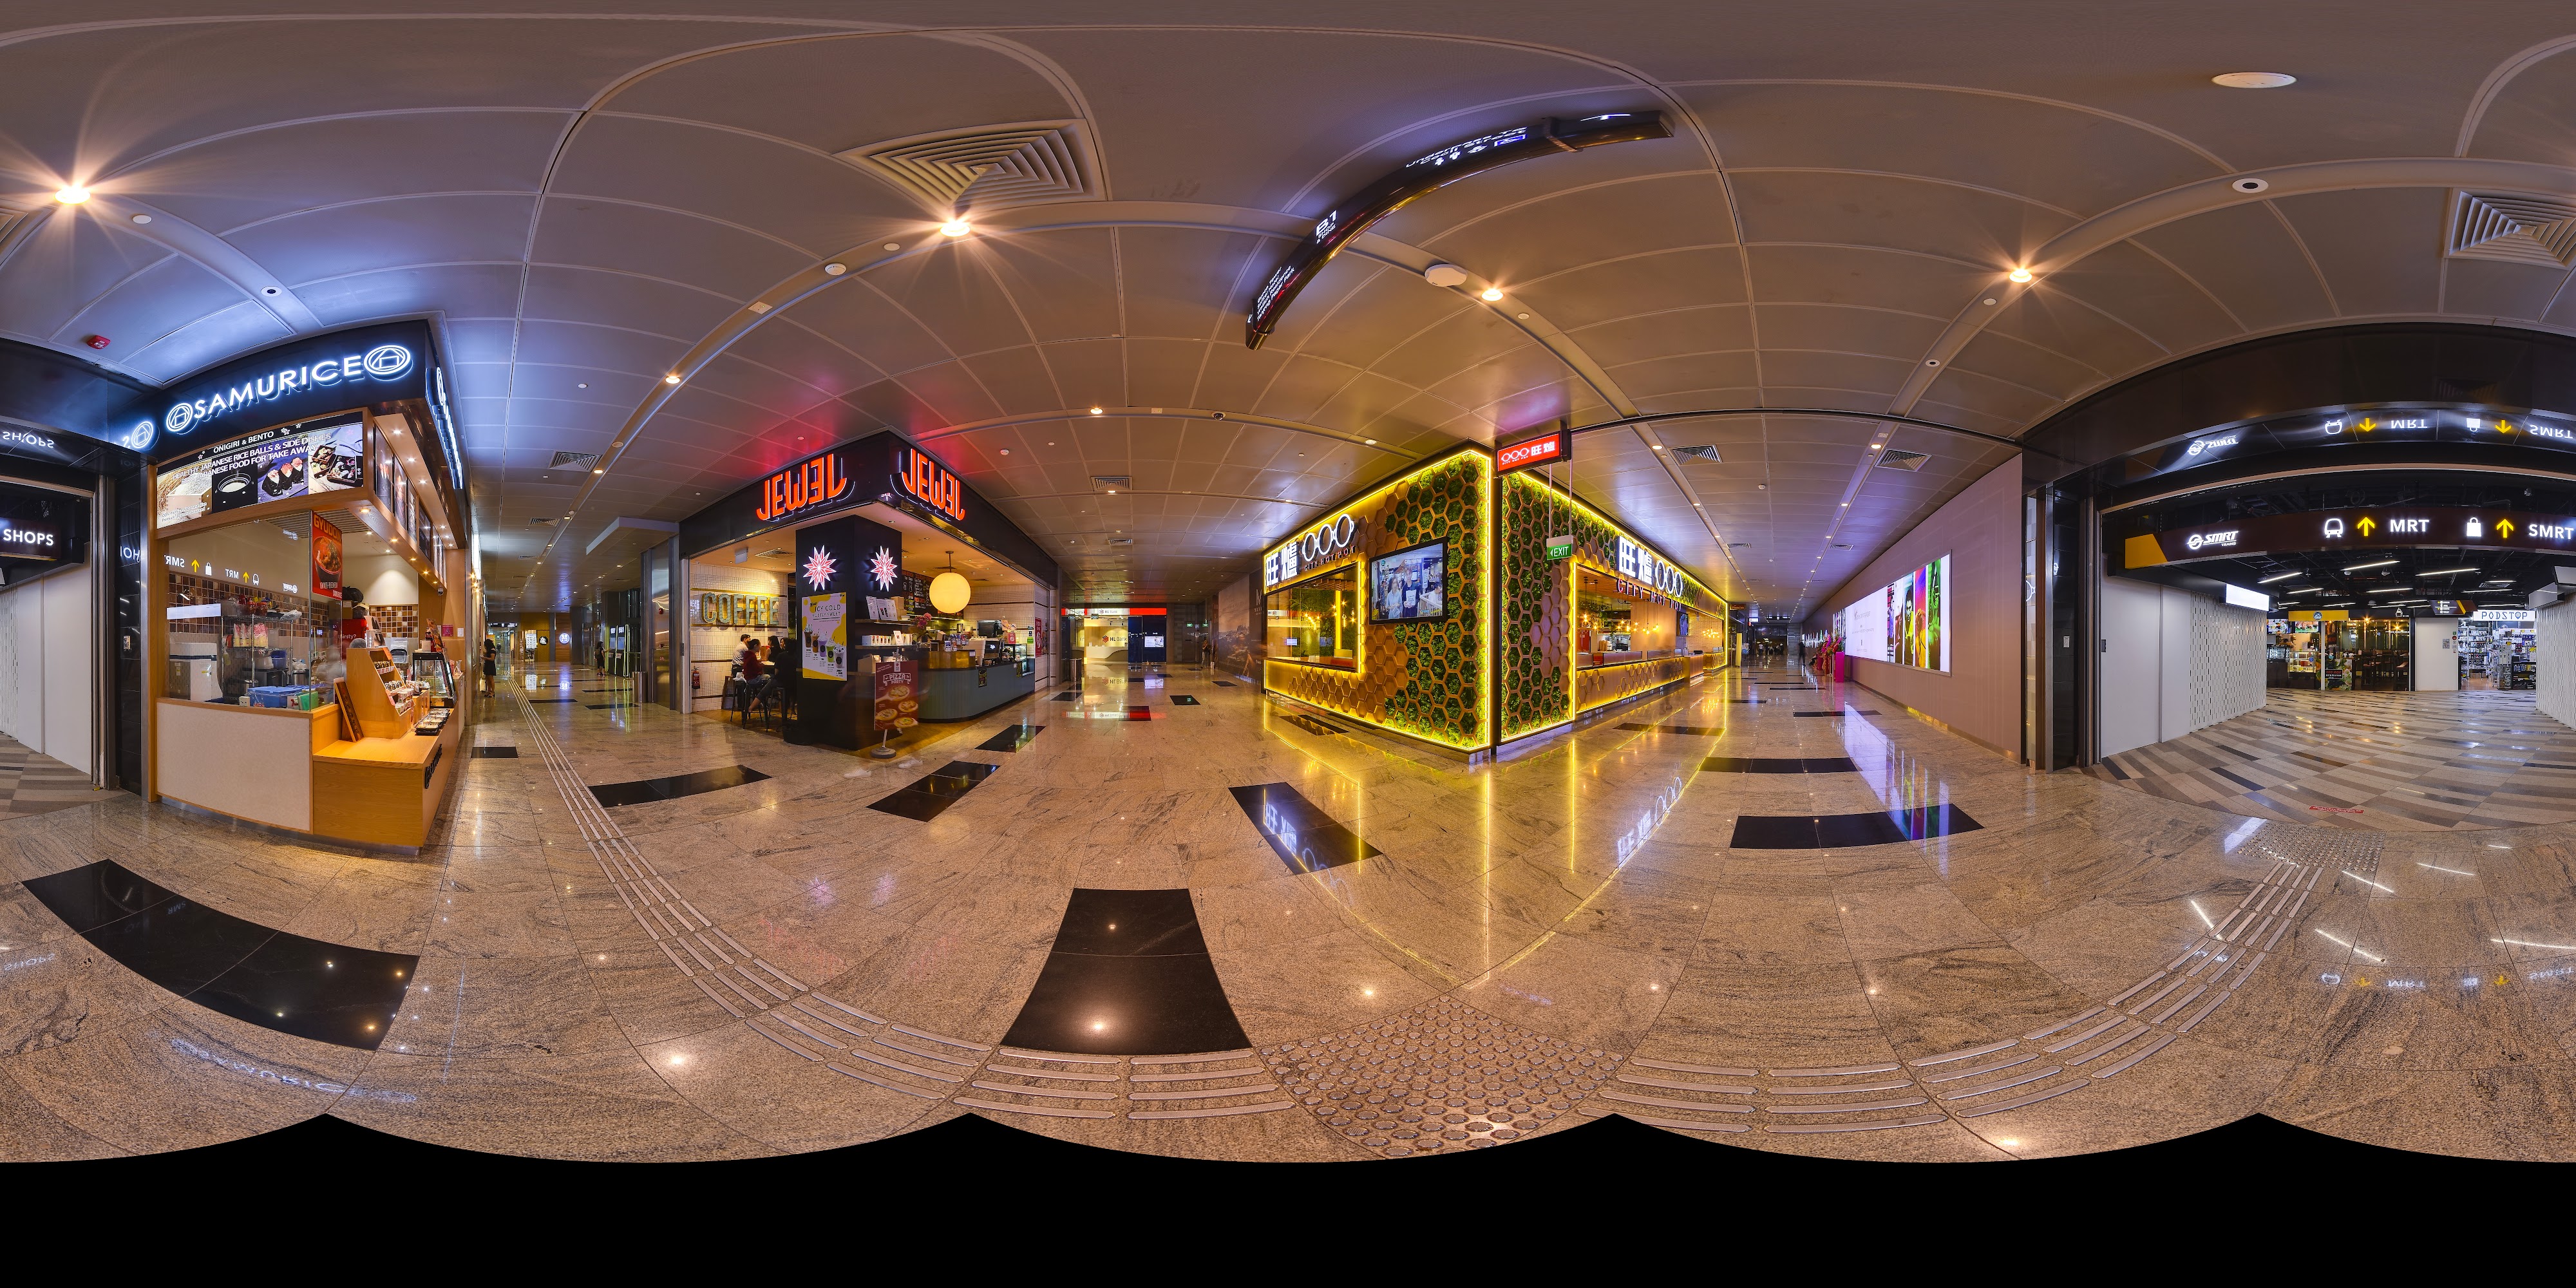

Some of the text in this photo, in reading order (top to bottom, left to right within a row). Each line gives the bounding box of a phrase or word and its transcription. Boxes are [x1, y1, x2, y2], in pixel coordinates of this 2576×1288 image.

[1316, 209, 1336, 236] B1
[1318, 222, 1334, 238] SHOP
[1322, 224, 1336, 239] DINE
[1284, 267, 1294, 283] Park
[194, 355, 362, 419] SAMURICE
[213, 440, 240, 453] ONIGIRI
[248, 431, 274, 444] BENTO
[173, 466, 199, 480] HEALTHY
[200, 457, 232, 472] JAPANESE
[233, 451, 249, 462] RICE
[250, 444, 273, 459] BALLS
[283, 439, 300, 449] SIDE
[301, 433, 331, 445] DISHES
[197, 466, 228, 479] JAPANESE
[229, 460, 250, 471] FOOD
[251, 455, 266, 465] FOR
[267, 450, 289, 460] TAKE
[290, 444, 317, 455] AWAY
[314, 515, 341, 541] GYUDON
[2390, 518, 2430, 533] MRT
[2528, 524, 2574, 540] SMRT
[3, 529, 54, 546] SHOPS
[2204, 531, 2239, 544] SMRT
[1305, 545, 1354, 571] CITY HOT POT
[1553, 546, 1569, 556] EXIT
[1617, 578, 1683, 611] CITY HOT POT
[703, 592, 779, 625] COFFEE
[2481, 611, 2528, 620] PODSTOP
